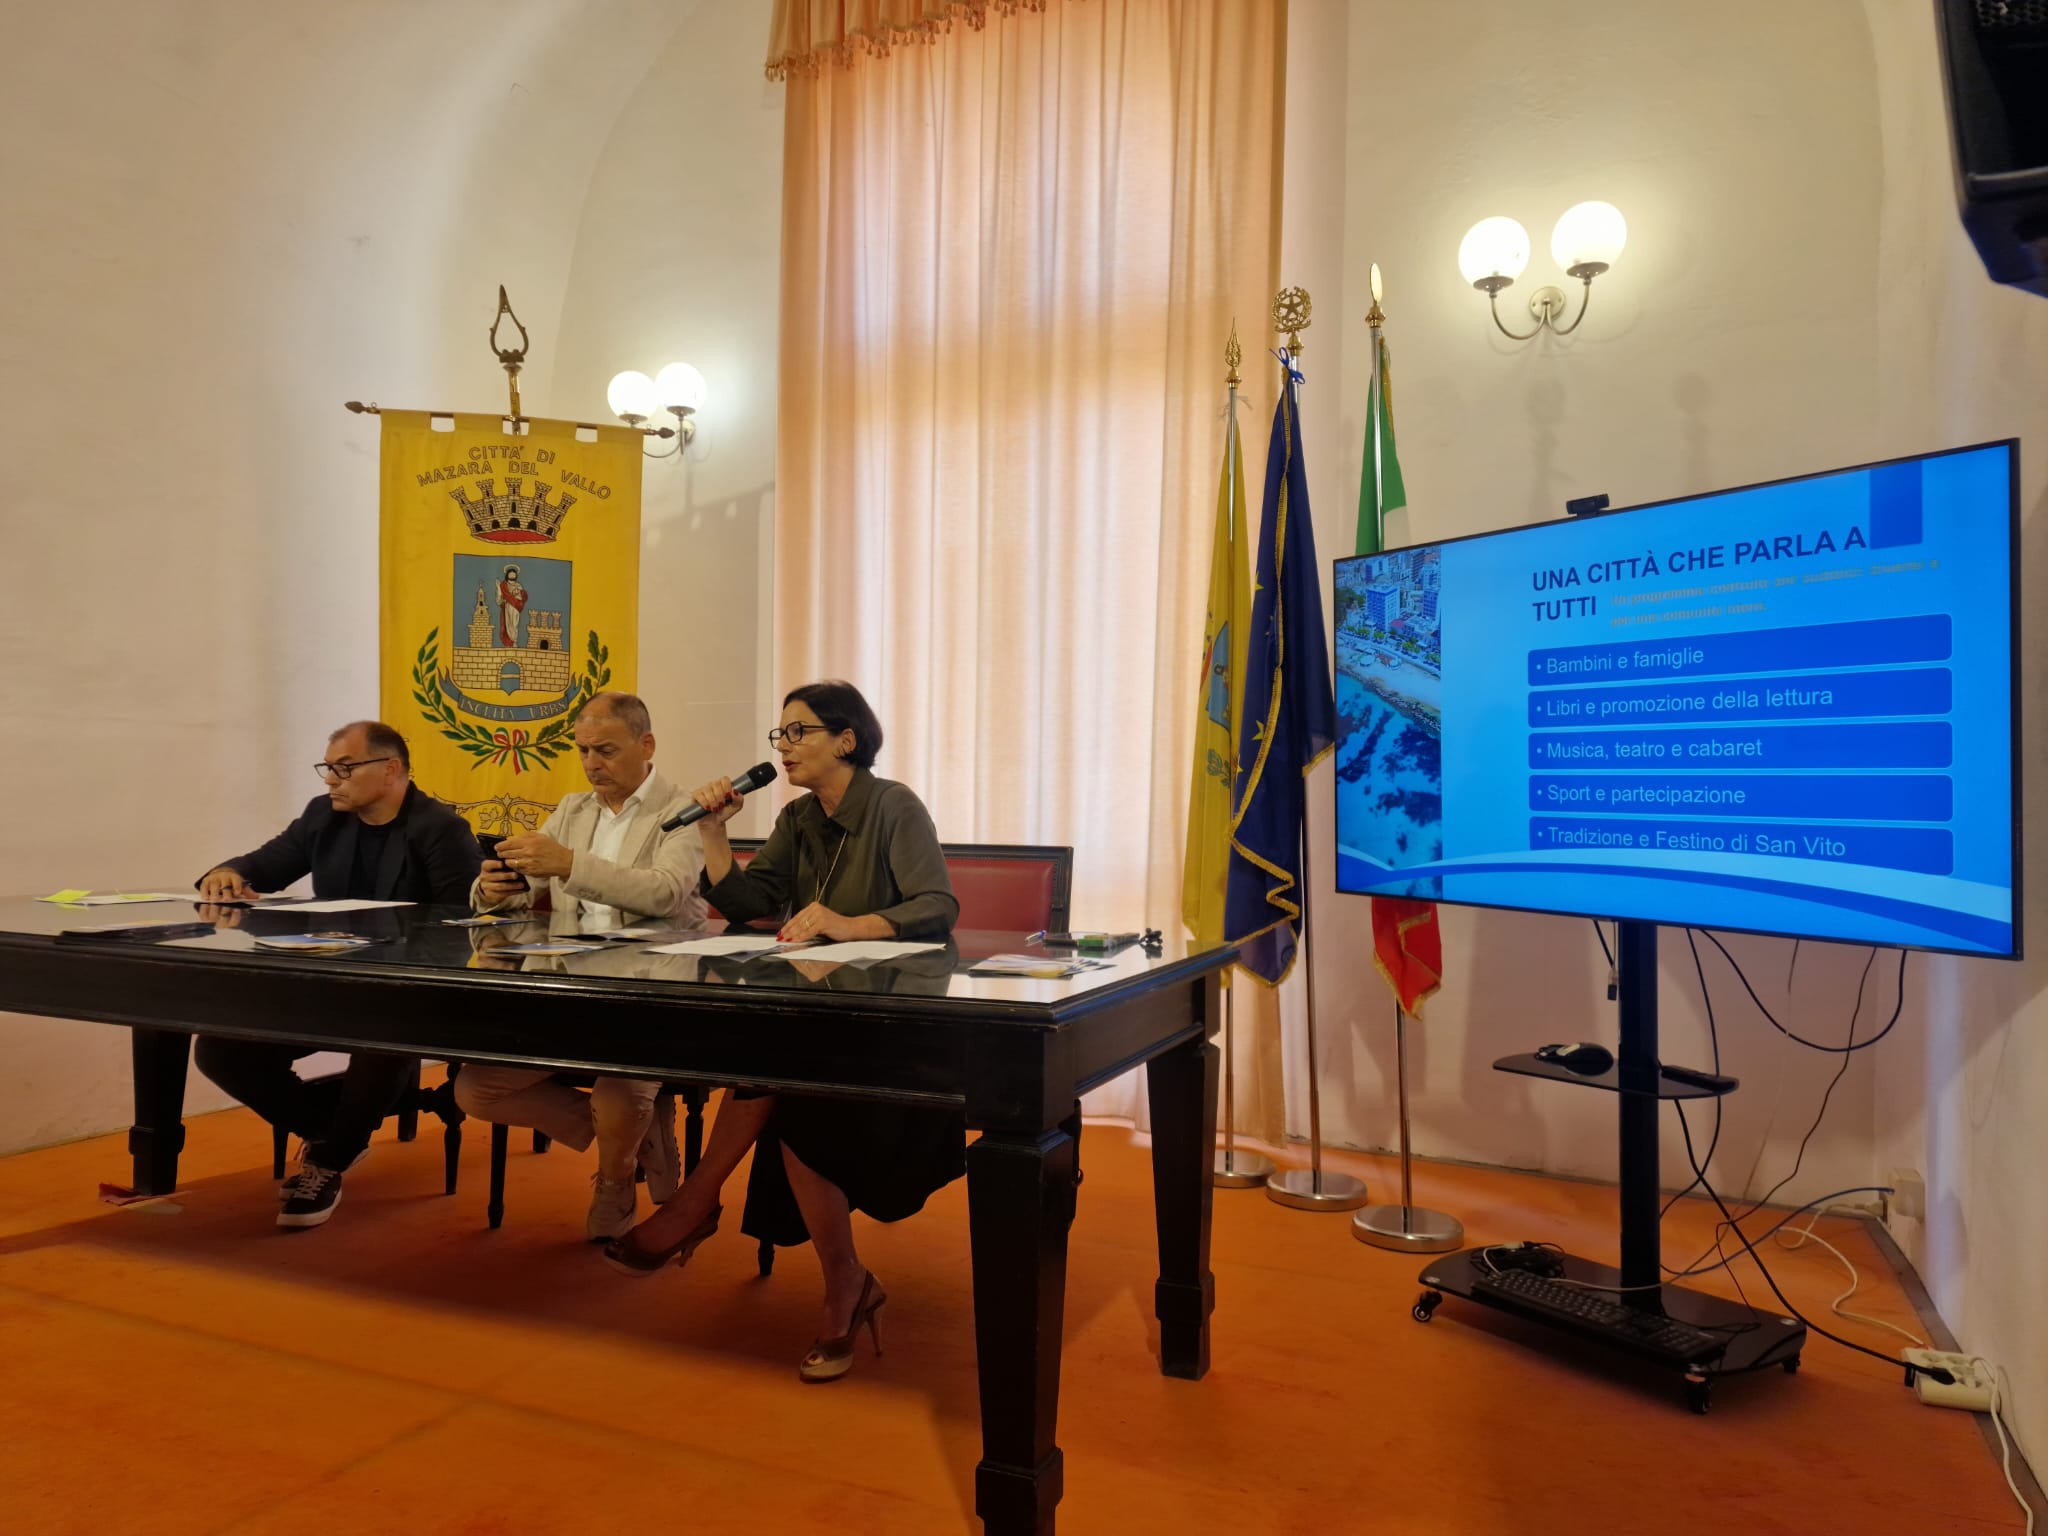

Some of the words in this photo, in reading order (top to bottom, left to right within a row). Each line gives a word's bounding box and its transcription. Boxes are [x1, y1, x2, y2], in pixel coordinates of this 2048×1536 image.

[536, 449, 556, 464] DI
[416, 461, 494, 487] MAZARA
[508, 461, 539, 476] DEL
[560, 469, 611, 500] VALLO
[1533, 566, 1581, 591] UNA
[1587, 550, 1660, 584] CITTÀ
[1668, 545, 1725, 573] CHE
[1734, 530, 1837, 565] PARLA
[1843, 526, 1867, 550] A
[1532, 595, 1597, 622] TUTTI
[1547, 653, 1612, 674] Bambini
[1617, 656, 1628, 669] e
[1633, 647, 1704, 669] famiglie
[1547, 699, 1580, 716] Libri
[1585, 702, 1596, 715] e
[1601, 694, 1706, 718] promozione
[1712, 690, 1759, 709] della
[1766, 689, 1833, 707] lettura
[1547, 741, 1609, 760] Musica,
[1615, 741, 1665, 757] teatro
[1671, 743, 1682, 757] e
[1688, 739, 1763, 757] cabaret
[1547, 784, 1590, 804] Sport
[1595, 789, 1606, 801] e
[1611, 785, 1746, 806] partecipazione
[1547, 827, 1633, 846] Tradizione
[1639, 834, 1650, 847] e
[1656, 831, 1725, 850] Festino
[1731, 834, 1748, 851] di
[1755, 834, 1796, 854] San
[1803, 836, 1846, 856] Vito
